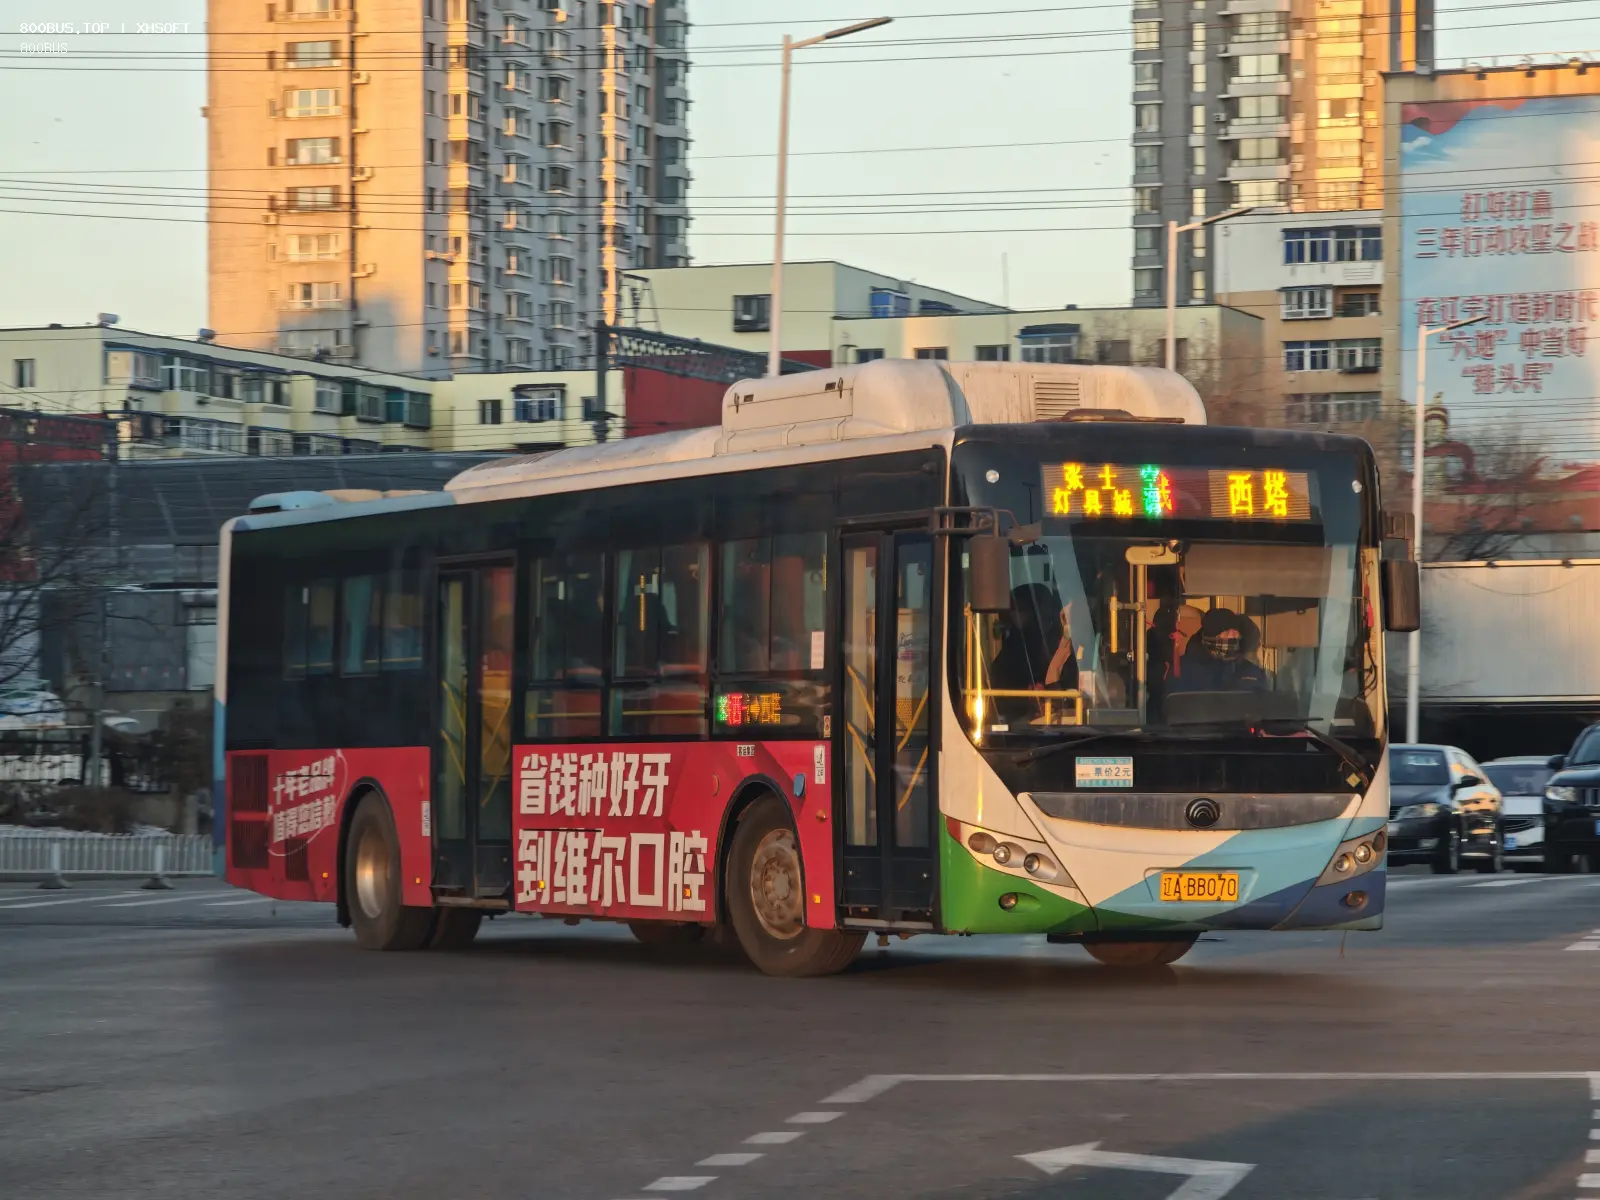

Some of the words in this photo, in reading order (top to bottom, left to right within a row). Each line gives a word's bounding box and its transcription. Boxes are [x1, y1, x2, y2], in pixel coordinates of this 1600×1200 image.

[1053, 487, 1133, 516] 灯具城
[1228, 471, 1289, 517] 西塔
[520, 751, 671, 817] 省钱种好牙
[1094, 766, 1131, 777] 票价2元
[517, 827, 708, 912] 到维尔口腔
